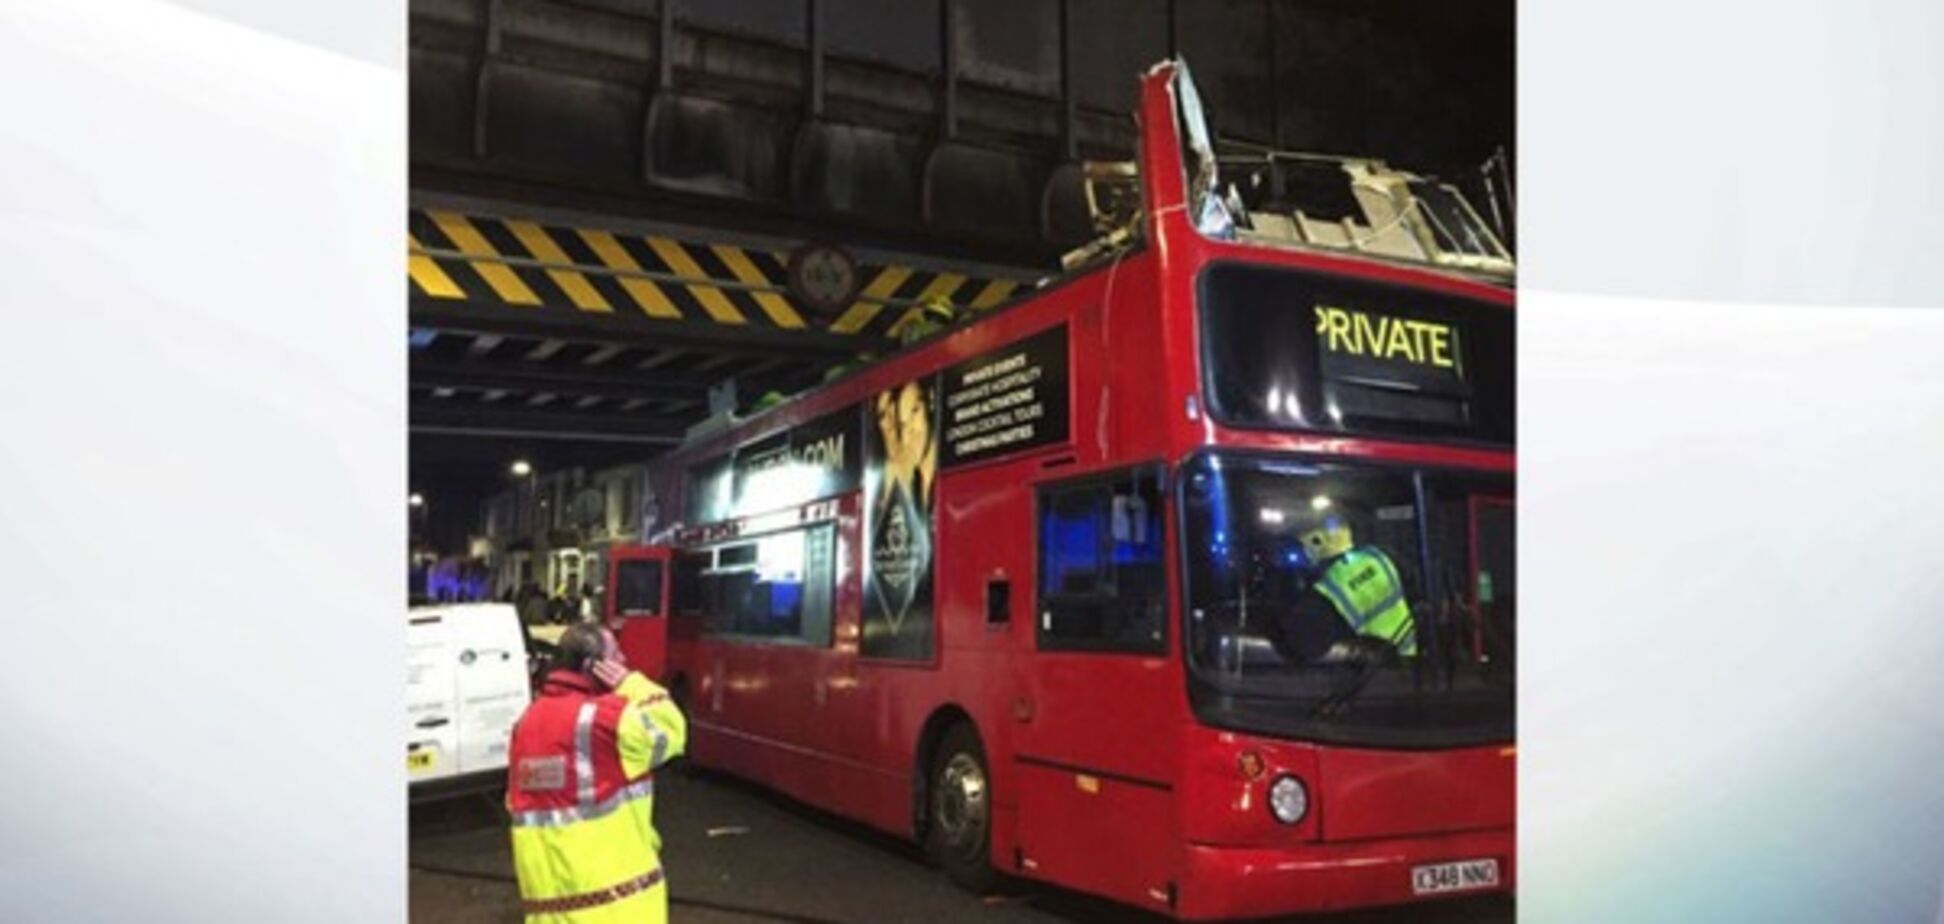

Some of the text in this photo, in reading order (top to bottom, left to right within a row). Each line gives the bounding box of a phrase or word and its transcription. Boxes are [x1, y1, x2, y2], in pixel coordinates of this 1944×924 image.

[994, 352, 1027, 374] EVENTS
[991, 366, 1042, 391] HOSPITALITY
[947, 423, 977, 442] LONDON
[1013, 402, 1043, 421] TOURS
